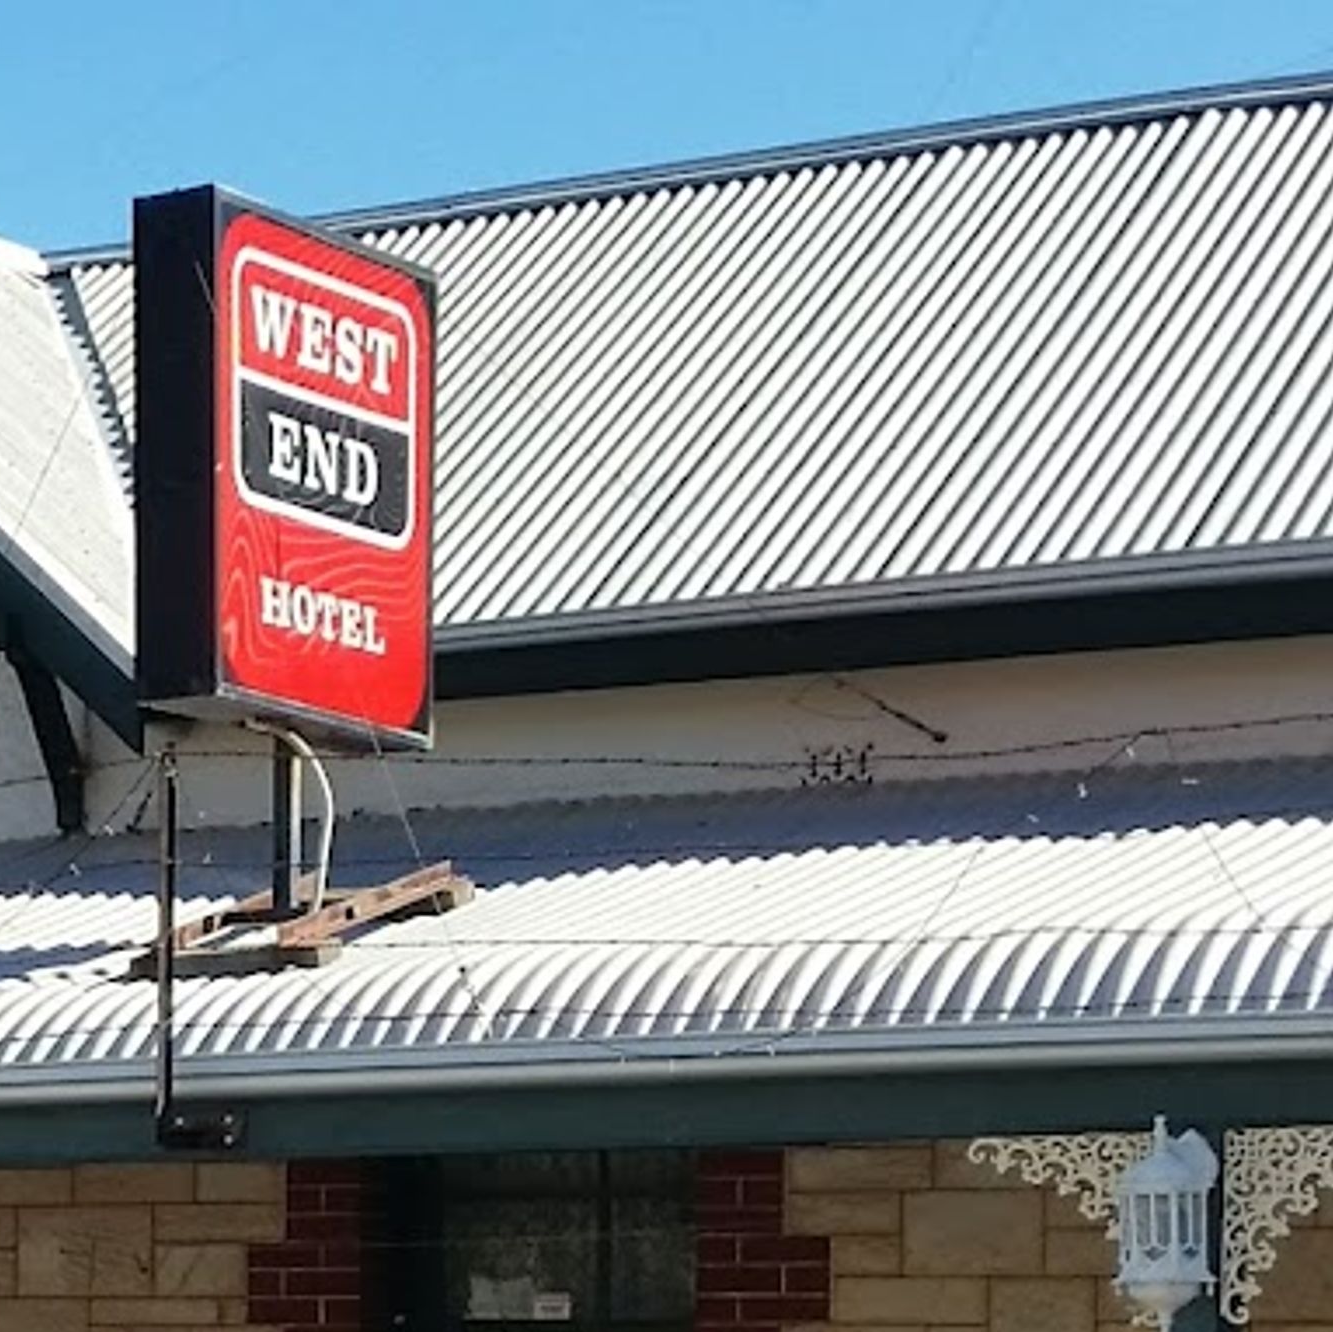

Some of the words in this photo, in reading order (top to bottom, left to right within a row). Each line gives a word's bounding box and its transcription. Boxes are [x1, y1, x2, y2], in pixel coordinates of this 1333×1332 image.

[250, 284, 398, 397] WEST
[267, 412, 379, 505] END
[259, 576, 386, 656] HOTEL
